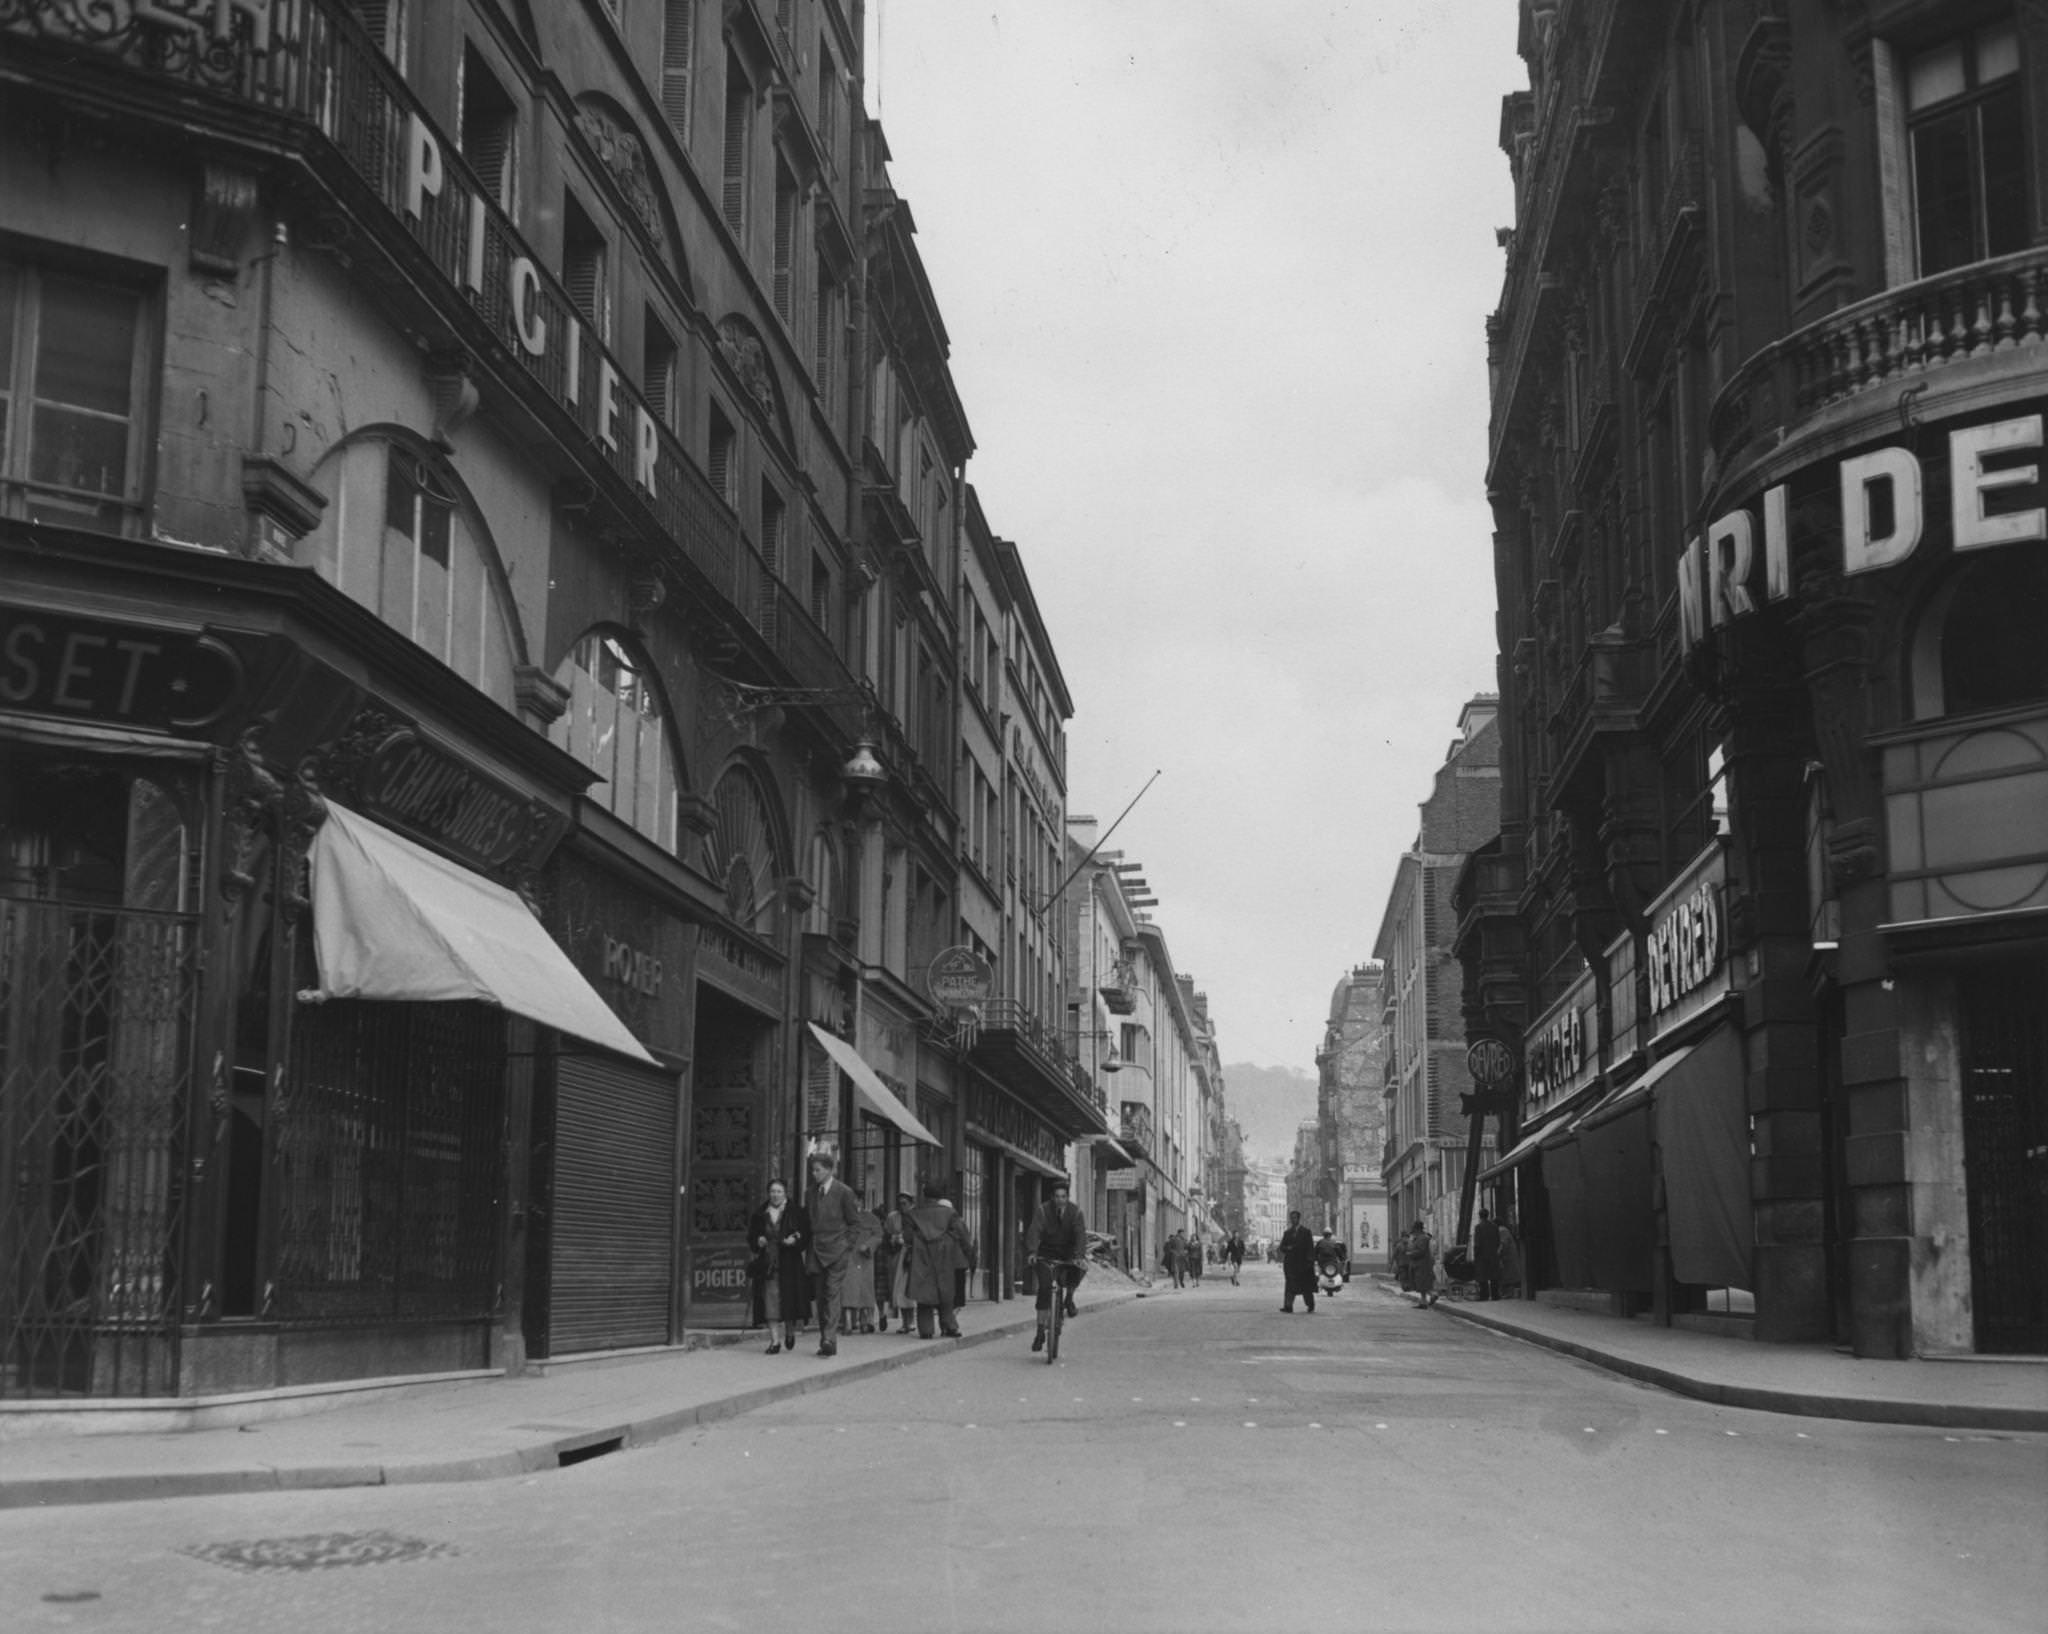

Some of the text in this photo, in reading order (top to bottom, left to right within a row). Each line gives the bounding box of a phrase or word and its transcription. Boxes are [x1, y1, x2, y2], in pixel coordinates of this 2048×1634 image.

[406, 111, 658, 499] PIGIER
[1840, 413, 2048, 578] DE
[0, 623, 163, 715] SET
[380, 747, 520, 857] CHAUSSURES
[1647, 881, 1718, 1016] DEVRED
[694, 1269, 747, 1288] PIGIER
